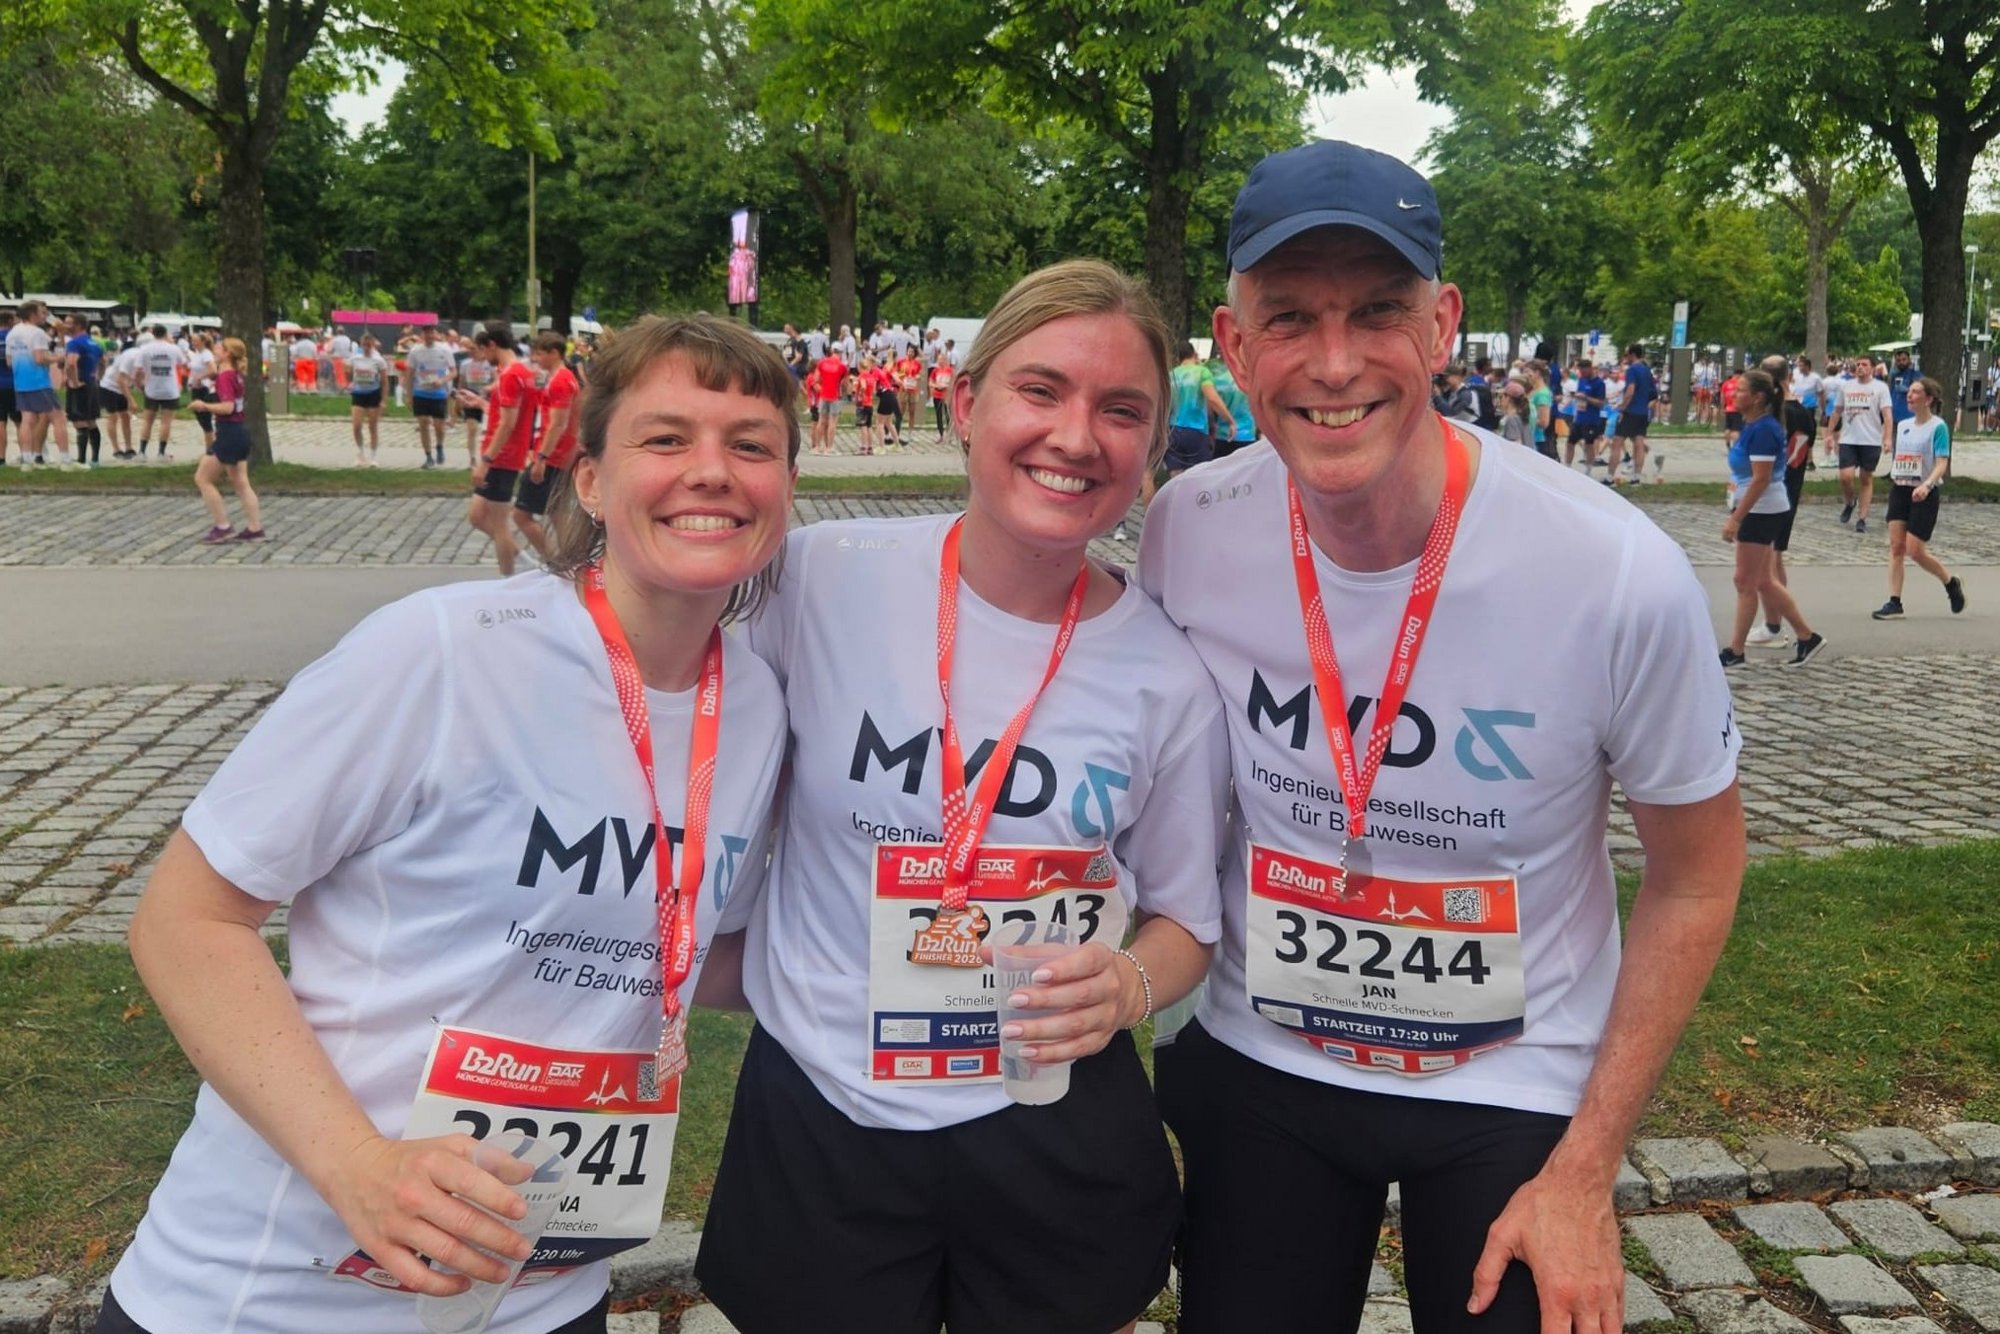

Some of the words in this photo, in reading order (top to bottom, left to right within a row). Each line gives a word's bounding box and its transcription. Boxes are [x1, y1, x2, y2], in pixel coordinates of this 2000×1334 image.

[497, 607, 536, 624] JAKO
[1251, 760, 1506, 829] Ingenieuesellschaft
[1291, 802, 1322, 825] für
[1329, 811, 1457, 850] Buwesen
[899, 856, 945, 878] B2R
[978, 859, 1015, 872] DAK
[1267, 860, 1326, 892] B2Run
[914, 952, 952, 962] FINISHER
[954, 953, 983, 964] 2026
[1275, 910, 1491, 984] 32244
[534, 957, 571, 984] für
[574, 963, 666, 997] Bauwese
[944, 995, 995, 1006] Schnelle
[1361, 984, 1396, 999] JAN
[1312, 993, 1358, 1008] Schnelle
[1361, 1000, 1454, 1018] MVD-Schnecken
[941, 1023, 997, 1036] STARTZ
[1313, 1016, 1386, 1036] STARTZEIT
[1389, 1028, 1429, 1042] 17:20
[1433, 1032, 1459, 1042] Uhr
[460, 1046, 542, 1083] B2Run
[548, 1062, 586, 1079] DAK
[456, 1072, 491, 1085] MÜNCHEN
[545, 1219, 598, 1232] chnecken
[559, 1248, 585, 1260] Uhr
